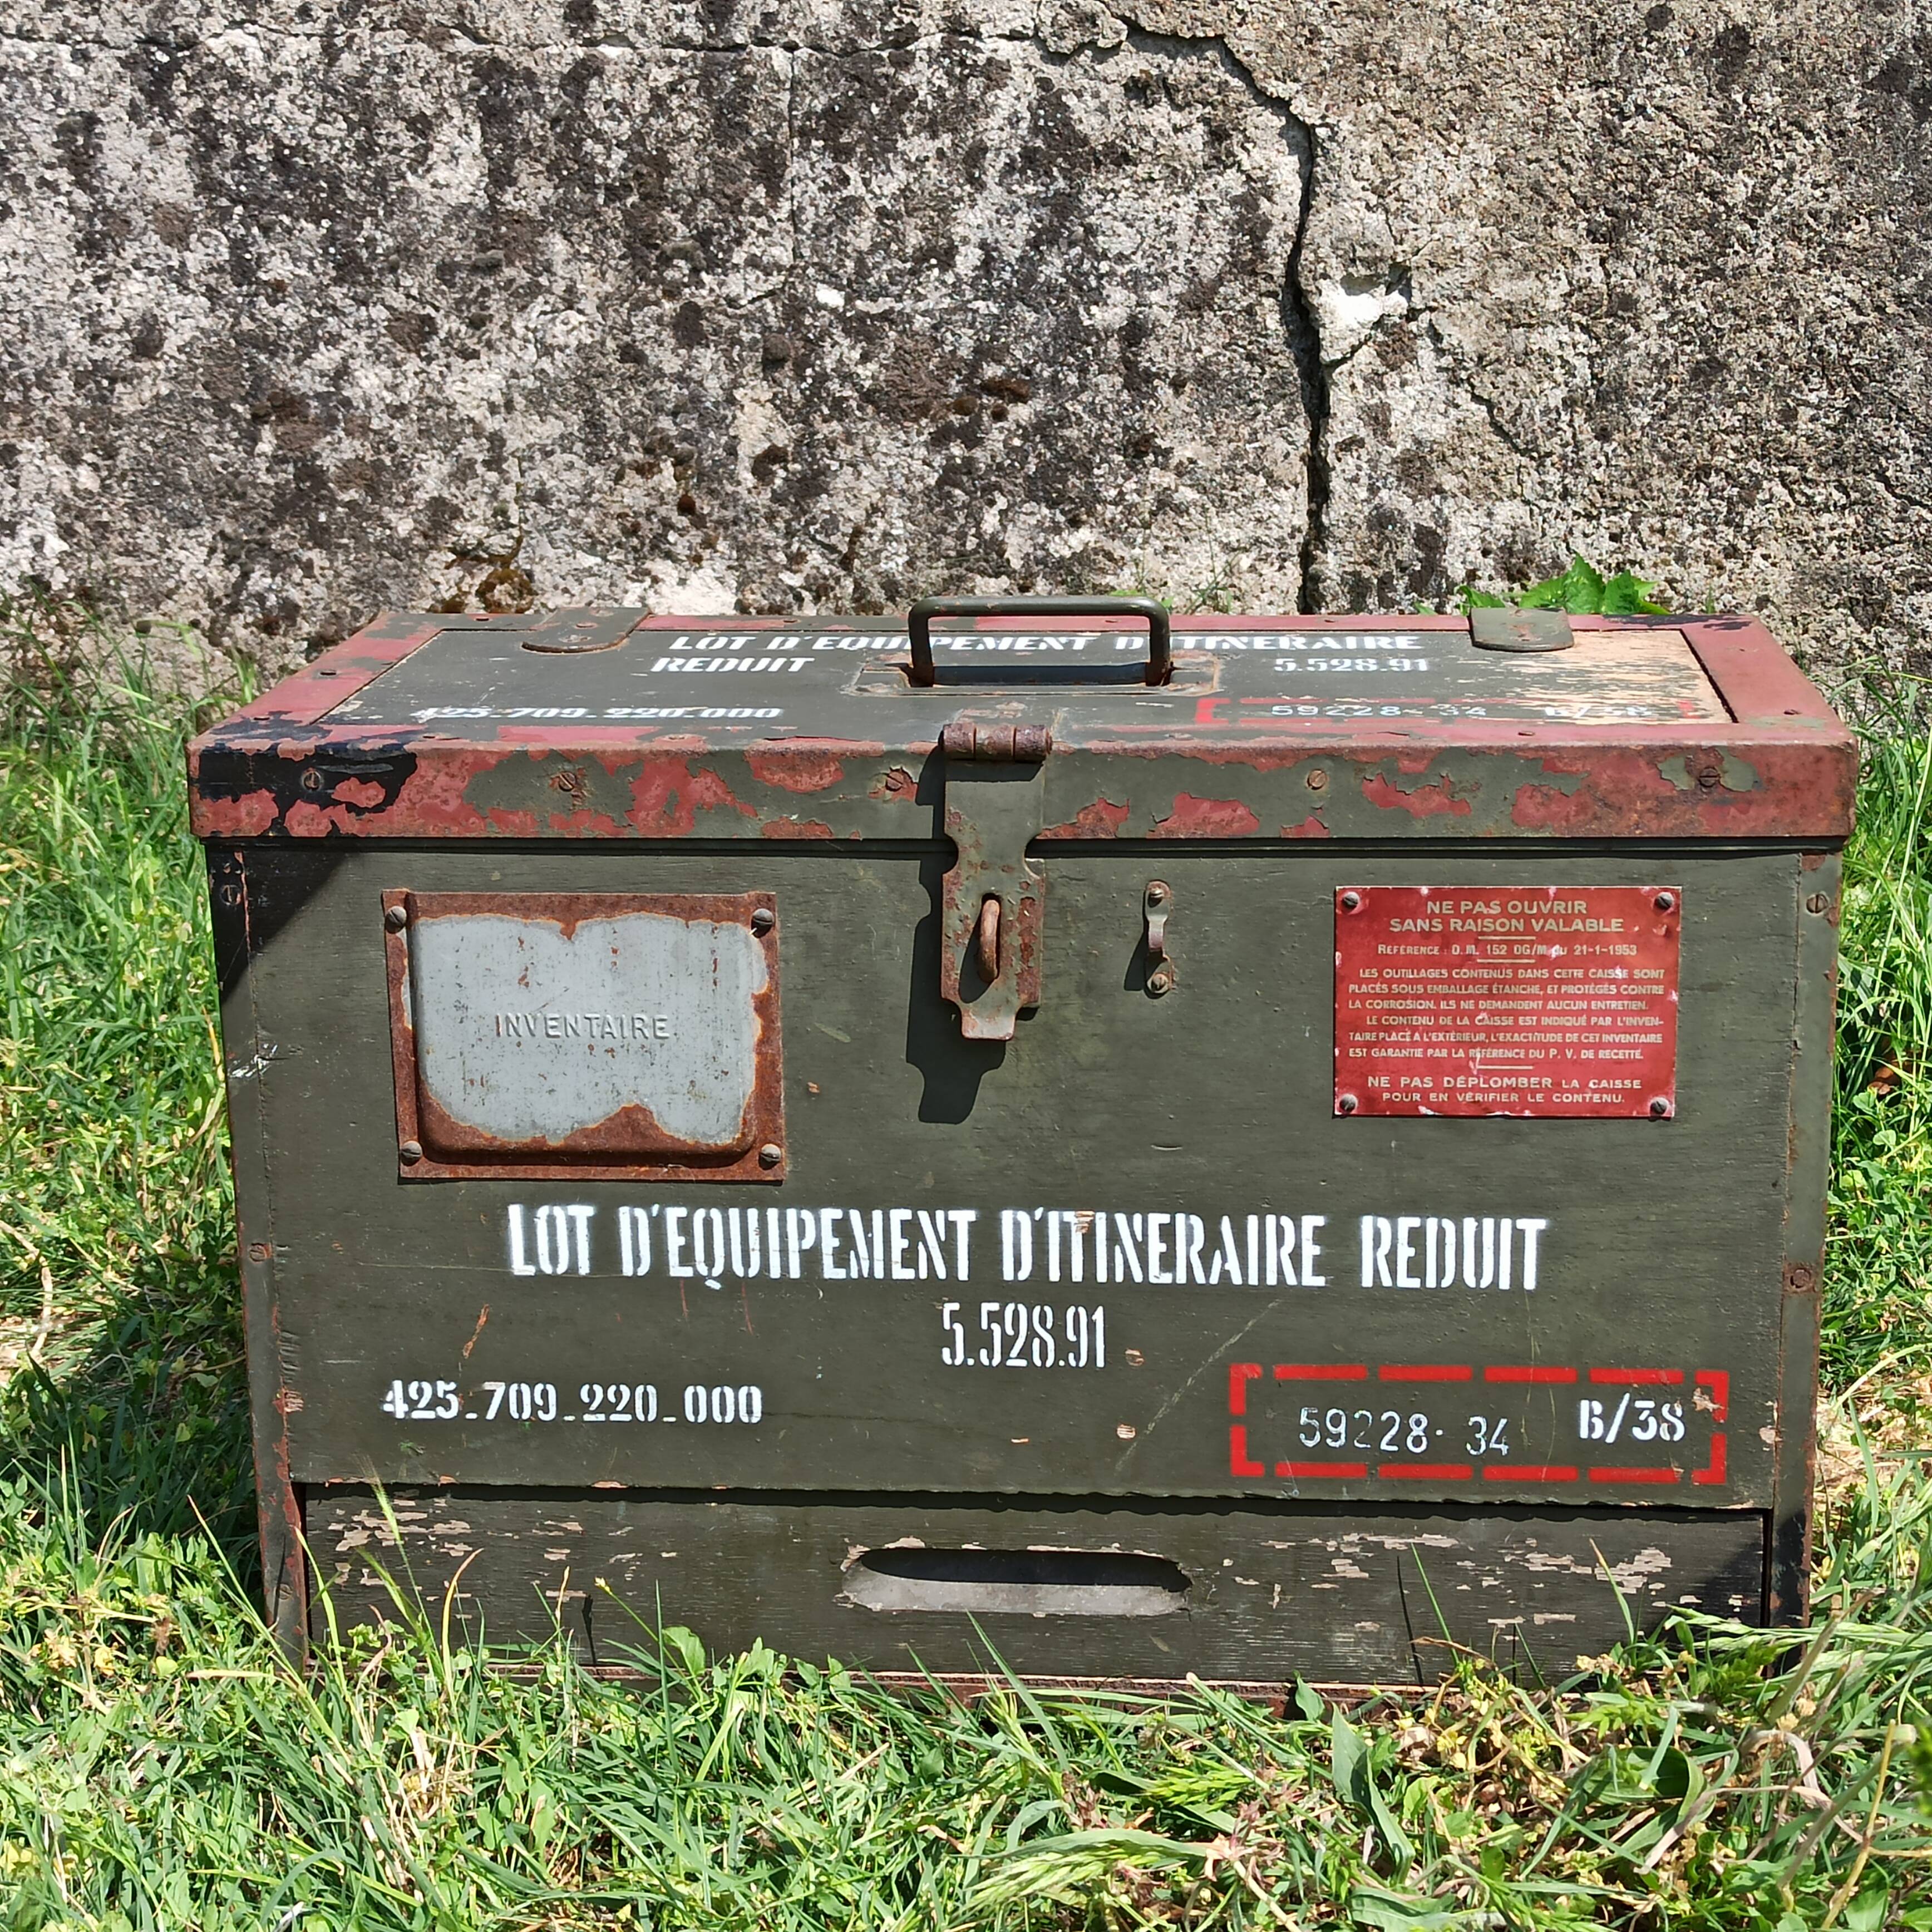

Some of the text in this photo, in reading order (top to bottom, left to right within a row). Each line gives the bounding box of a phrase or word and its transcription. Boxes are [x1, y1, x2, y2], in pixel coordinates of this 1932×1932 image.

[669, 636, 757, 650] LOT
[651, 657, 815, 672] REDUIT
[1274, 658, 1428, 672] 5.528.91
[1427, 901, 1587, 914] NE PAS OUVRIR
[1389, 918, 1624, 933] SANS RAISON VALABLE
[1487, 944, 1507, 955] 152
[1573, 944, 1638, 955] 21-1-1953
[1359, 969, 1664, 979] LES OUTILLAGES CONTENUS DANS CETTE CAISSE SONT
[1348, 980, 1664, 995] PLACÉS SOUS EMBALLAGE ÉTANCHE, ET PROTÉGÉS CONTRE
[1348, 1000, 1648, 1010] LA CORROSION. ILS NE DEMANDENT AUCUN ENTRETIEN.
[495, 1013, 670, 1039] INVENTAIRE
[1366, 1014, 1664, 1026] LE CONTENU DE LA CAISSE EST INDIQUÉ PAR L'INVEN-
[1349, 1032, 1377, 1041] TAIRE
[1379, 1029, 1412, 1041] PLACÉ
[1491, 1032, 1563, 1042] L'EXACTITUDE
[1565, 1033, 1579, 1042] DE
[1581, 1033, 1600, 1042] CET
[1602, 1033, 1663, 1043] INVENTAIRE
[1349, 1048, 1367, 1057] EST
[1371, 1048, 1423, 1057] GARANTIE
[1427, 1048, 1448, 1057] PAR
[1452, 1048, 1465, 1057] LA
[1529, 1049, 1545, 1058] DU
[1549, 1049, 1560, 1059] P.
[1565, 1049, 1576, 1059] V.
[1580, 1049, 1595, 1059] DE
[1367, 1075, 1642, 1088] NE PAS DÉPLOMBER LA CAISSE
[1382, 1091, 1625, 1102] POUR EN VÉRIFIER LE CONTENU.
[507, 1202, 1547, 1291] LOT D'EQUIPEMENT D'ITINERAIRE REDUIT
[942, 1302, 1105, 1368] 5.528.91
[1466, 1415, 1510, 1456] 34
[1579, 1392, 1685, 1444] B/38
